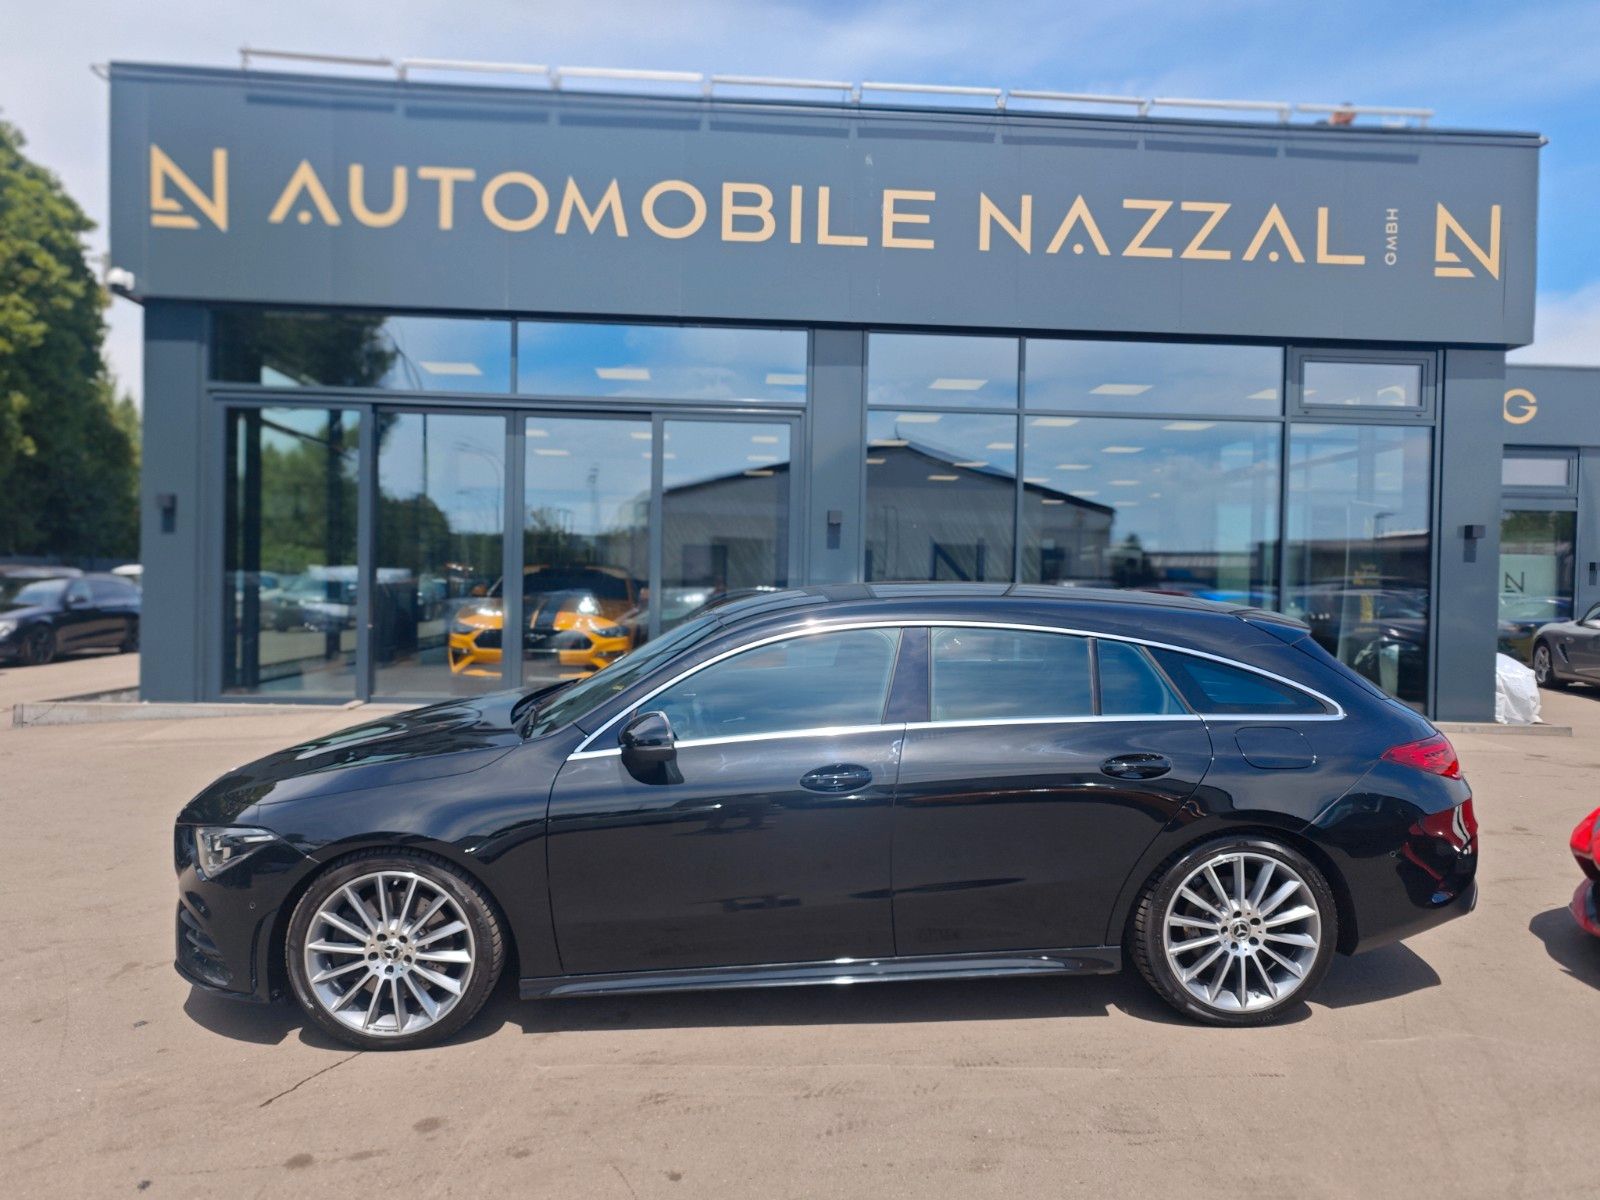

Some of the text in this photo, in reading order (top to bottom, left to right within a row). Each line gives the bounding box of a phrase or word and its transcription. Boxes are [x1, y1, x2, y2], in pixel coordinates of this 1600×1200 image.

[268, 159, 936, 250] AUTOMOBILE
[979, 192, 1366, 265] NAZZAL
[1384, 207, 1399, 266] GMBH
